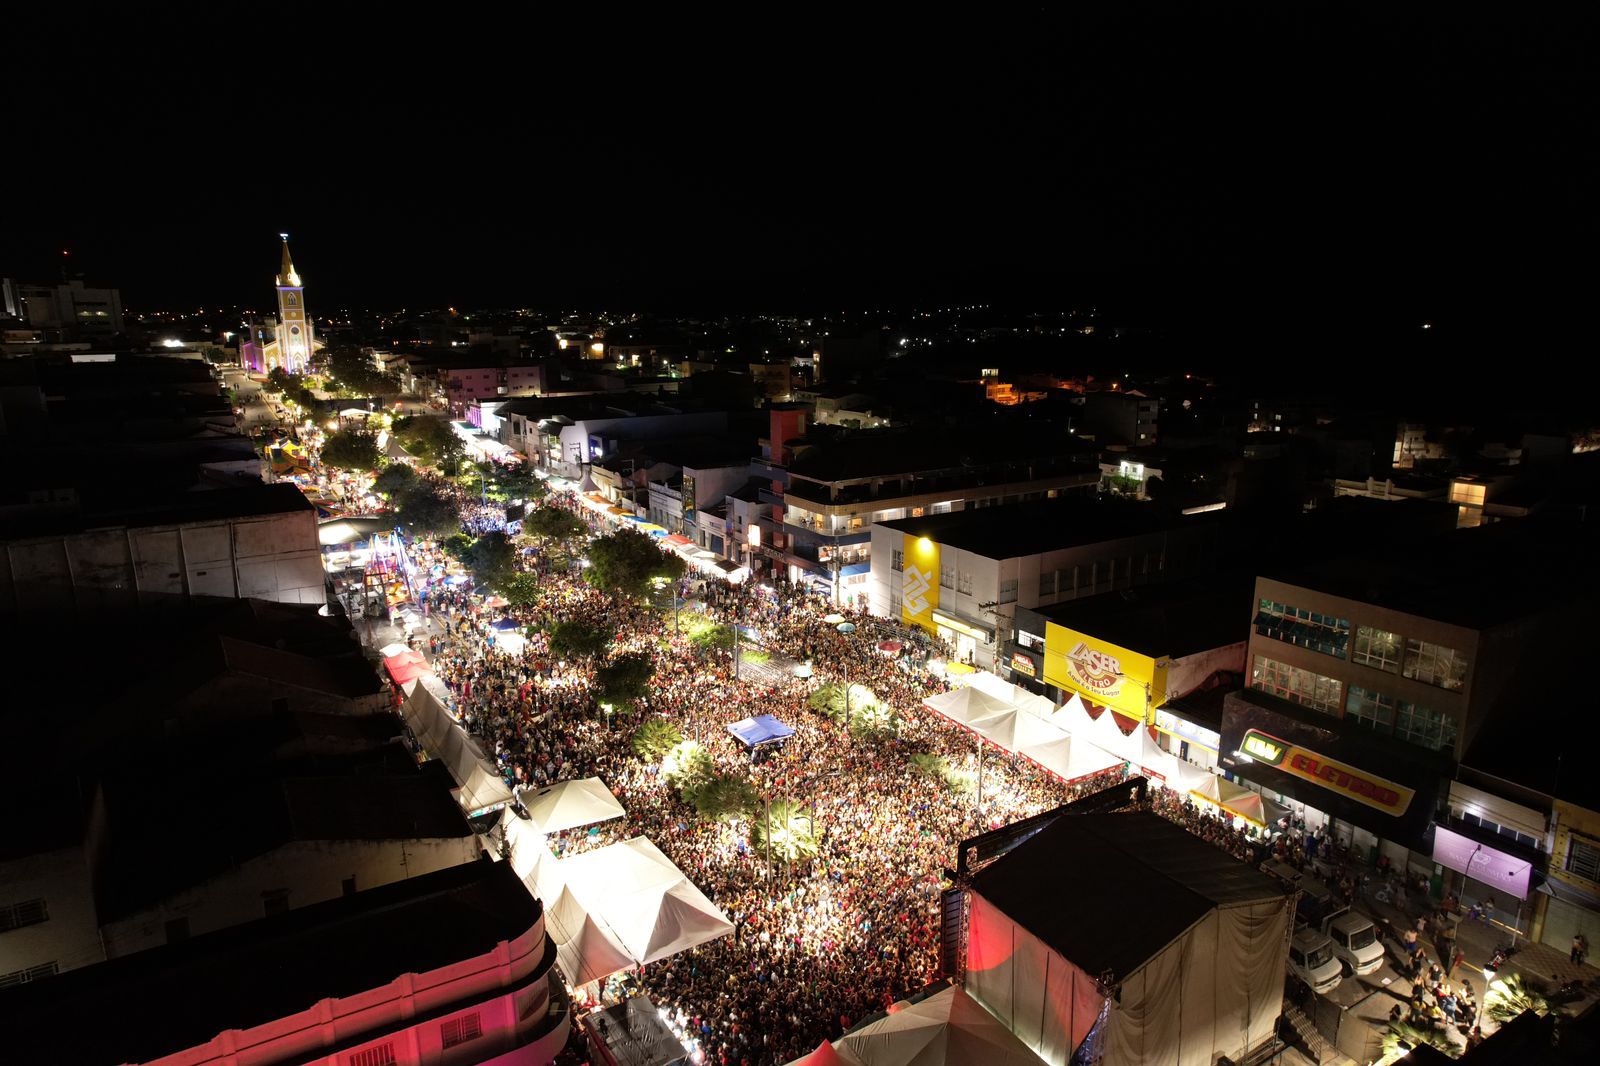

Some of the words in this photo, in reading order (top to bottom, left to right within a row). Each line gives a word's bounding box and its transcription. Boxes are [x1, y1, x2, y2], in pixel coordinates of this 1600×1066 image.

[1068, 643, 1121, 675] LASER
[1079, 669, 1111, 688] ELETRO
[1290, 754, 1399, 807] ELETRO
